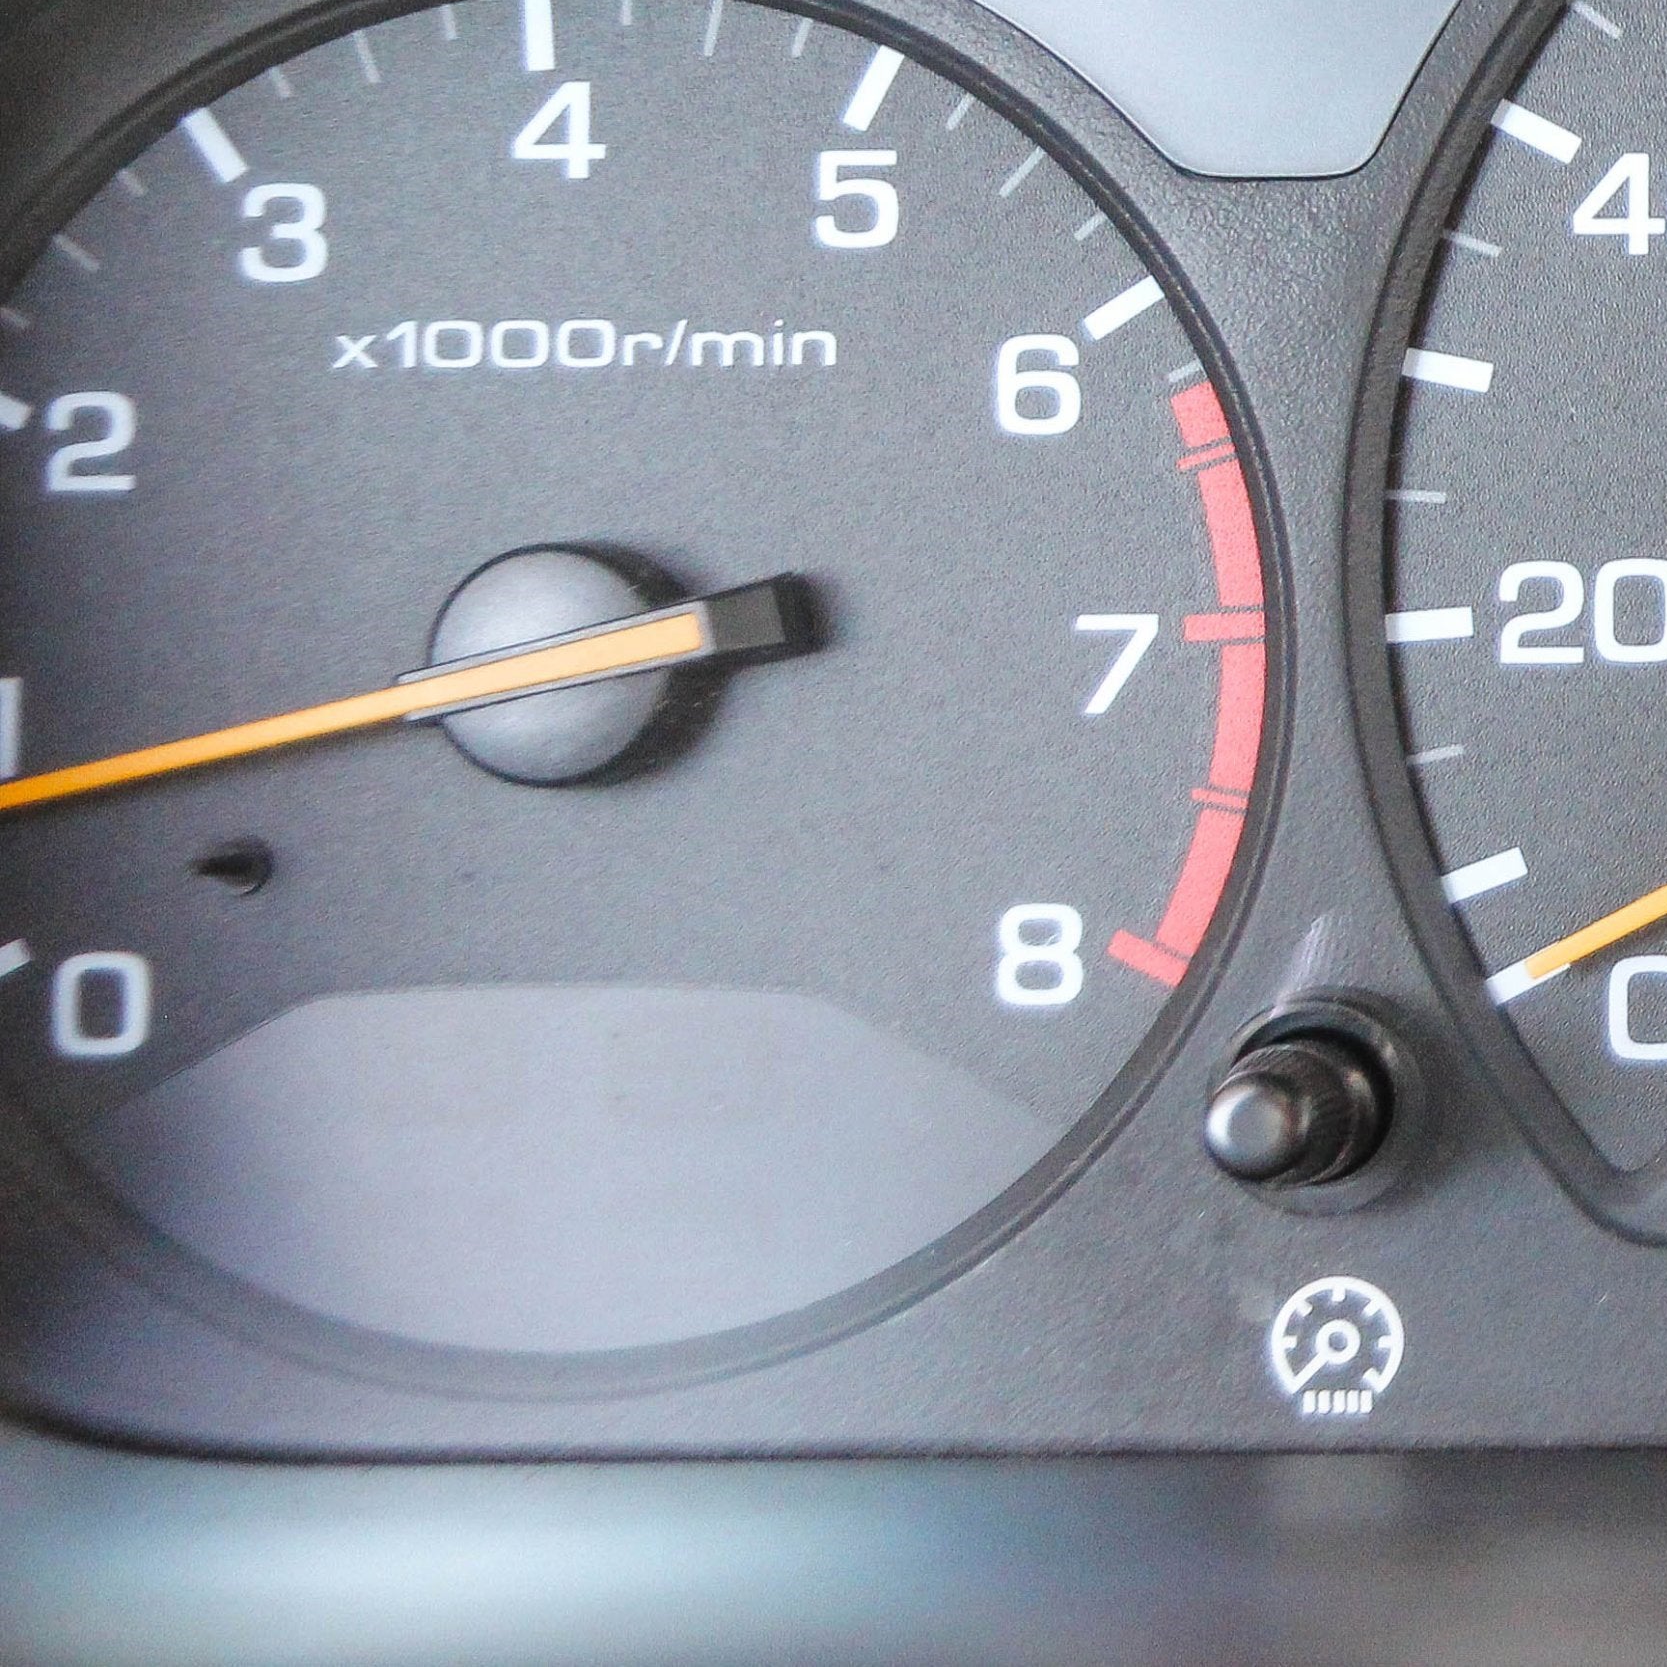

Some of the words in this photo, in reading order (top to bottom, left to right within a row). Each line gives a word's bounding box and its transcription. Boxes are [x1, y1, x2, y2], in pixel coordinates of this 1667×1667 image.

[513, 82, 605, 178] 4
[242, 184, 327, 282] 3
[815, 151, 898, 248] 5
[335, 320, 836, 368] x1000r/min
[996, 335, 1080, 435] 6
[50, 392, 134, 491] 2
[1075, 614, 1158, 714] 7
[56, 952, 150, 1055] 0
[996, 904, 1083, 1006] 8
